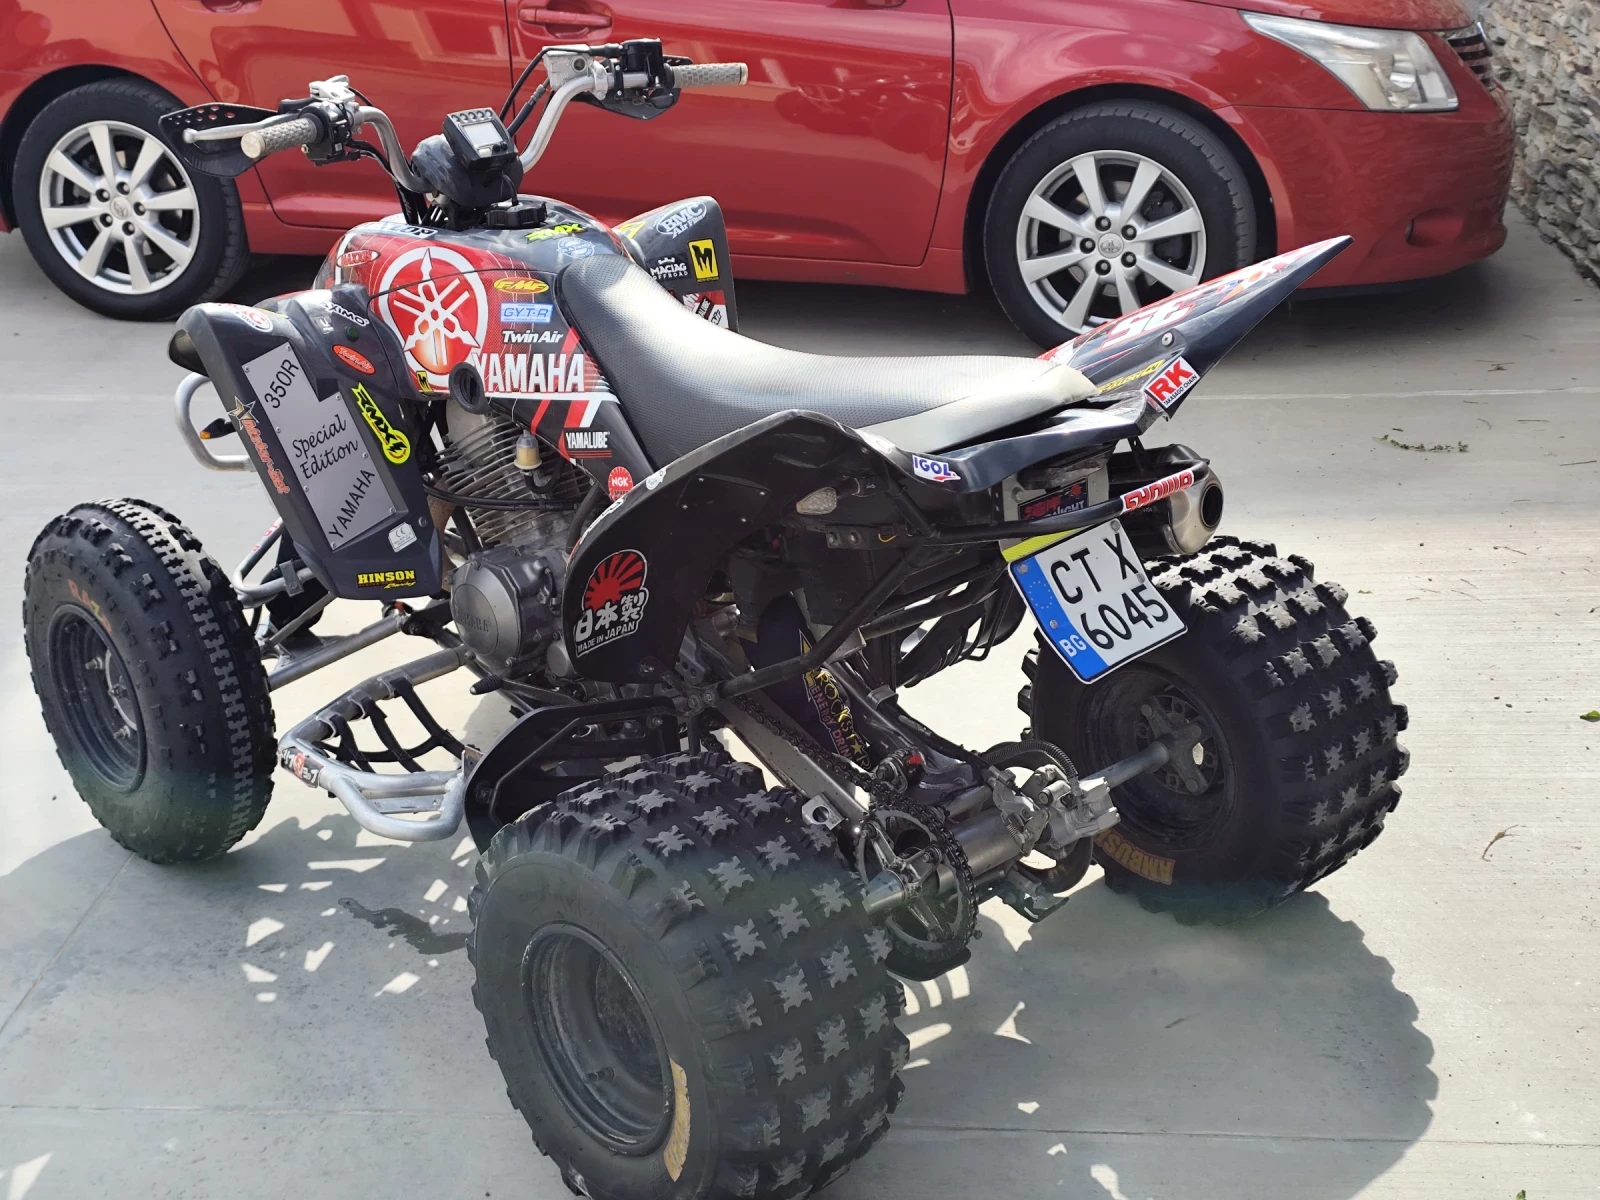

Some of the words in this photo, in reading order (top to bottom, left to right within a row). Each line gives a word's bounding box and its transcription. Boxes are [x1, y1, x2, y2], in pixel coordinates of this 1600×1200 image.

[661, 204, 703, 233] BMC
[650, 262, 687, 276] MACIAG
[652, 271, 688, 280] OFFROAD
[496, 280, 547, 291] FMF
[502, 330, 539, 343] Twin
[538, 331, 563, 343] Air
[264, 359, 299, 408] 350R
[471, 352, 585, 393] YAMAHA
[1149, 360, 1193, 402] RK
[1183, 374, 1198, 388] CHAIN
[292, 413, 347, 460] Special
[565, 431, 609, 449] YAMALUBE
[299, 439, 359, 479] Edition
[914, 457, 951, 477] IGOL
[611, 477, 629, 487] NGK
[328, 469, 375, 538] YAMAHA
[357, 570, 415, 585] HINSON
[1050, 547, 1102, 605] CT
[1103, 532, 1139, 581] X
[576, 591, 645, 642] 日本製
[1080, 583, 1169, 650] 6045
[577, 638, 596, 654] MADE
[596, 634, 604, 645] IN
[604, 621, 635, 640] JAPAN
[1058, 634, 1088, 658] BG
[810, 685, 837, 725] ENERGY
[831, 729, 853, 760] DRIN
